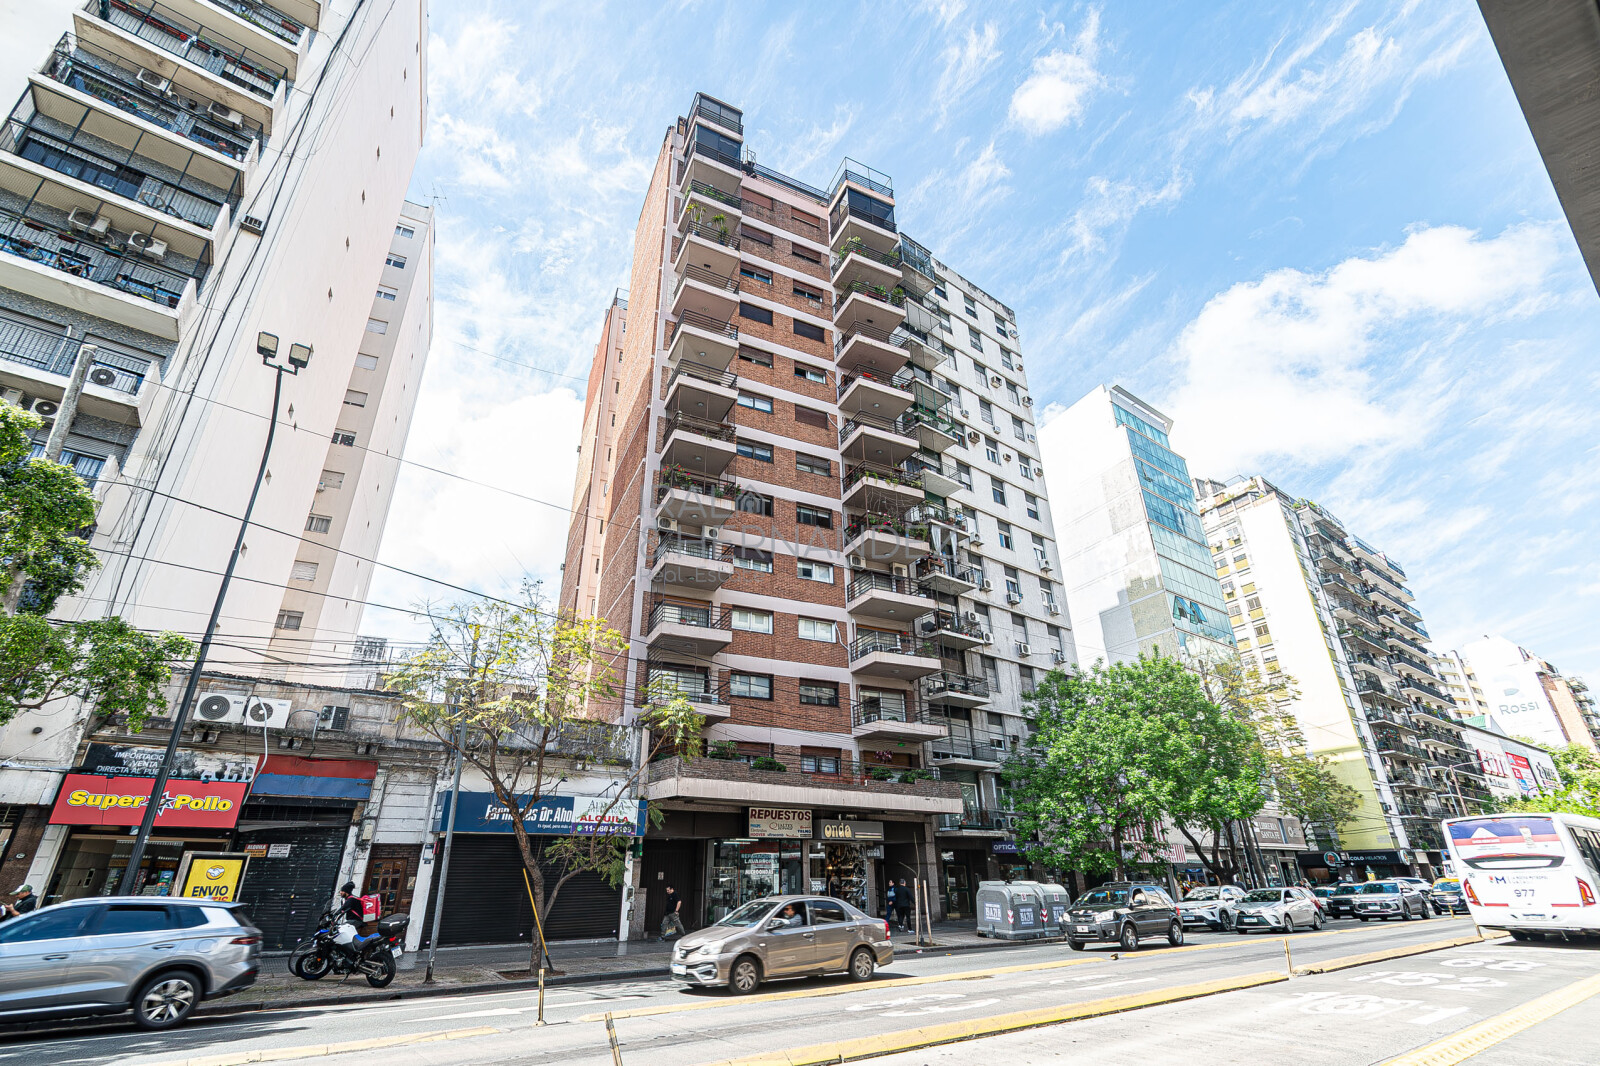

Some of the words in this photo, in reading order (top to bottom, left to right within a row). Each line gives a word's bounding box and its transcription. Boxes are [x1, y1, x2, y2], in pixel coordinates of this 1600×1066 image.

[114, 751, 165, 761] IMPORTACIO
[96, 766, 129, 774] DIRECTA
[68, 790, 145, 810] Super
[173, 795, 233, 811] Pollo
[540, 806, 553, 822] Dr.
[750, 809, 811, 821] REPUESTOS
[824, 822, 852, 838] onda
[191, 885, 229, 897] ENVIO
[1514, 889, 1535, 898] 977
